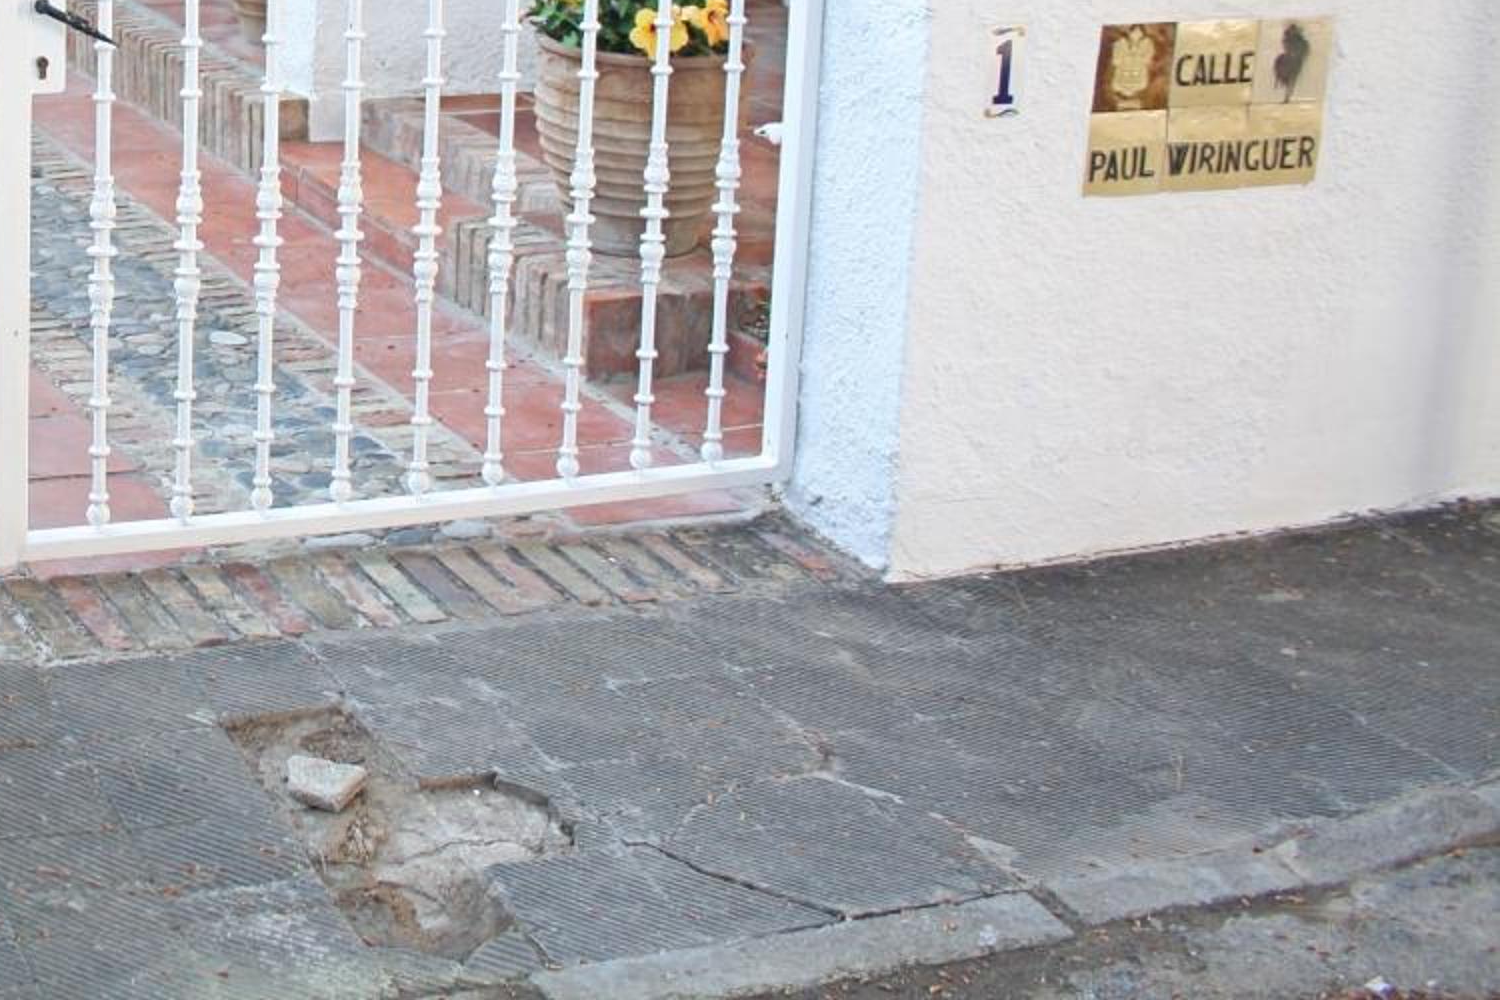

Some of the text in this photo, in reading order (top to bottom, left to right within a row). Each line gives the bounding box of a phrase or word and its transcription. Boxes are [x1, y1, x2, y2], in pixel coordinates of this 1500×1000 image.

[993, 40, 1013, 104] 1
[1175, 52, 1255, 86] CALLE
[1088, 136, 1316, 183] PAUL WIRINGUER
